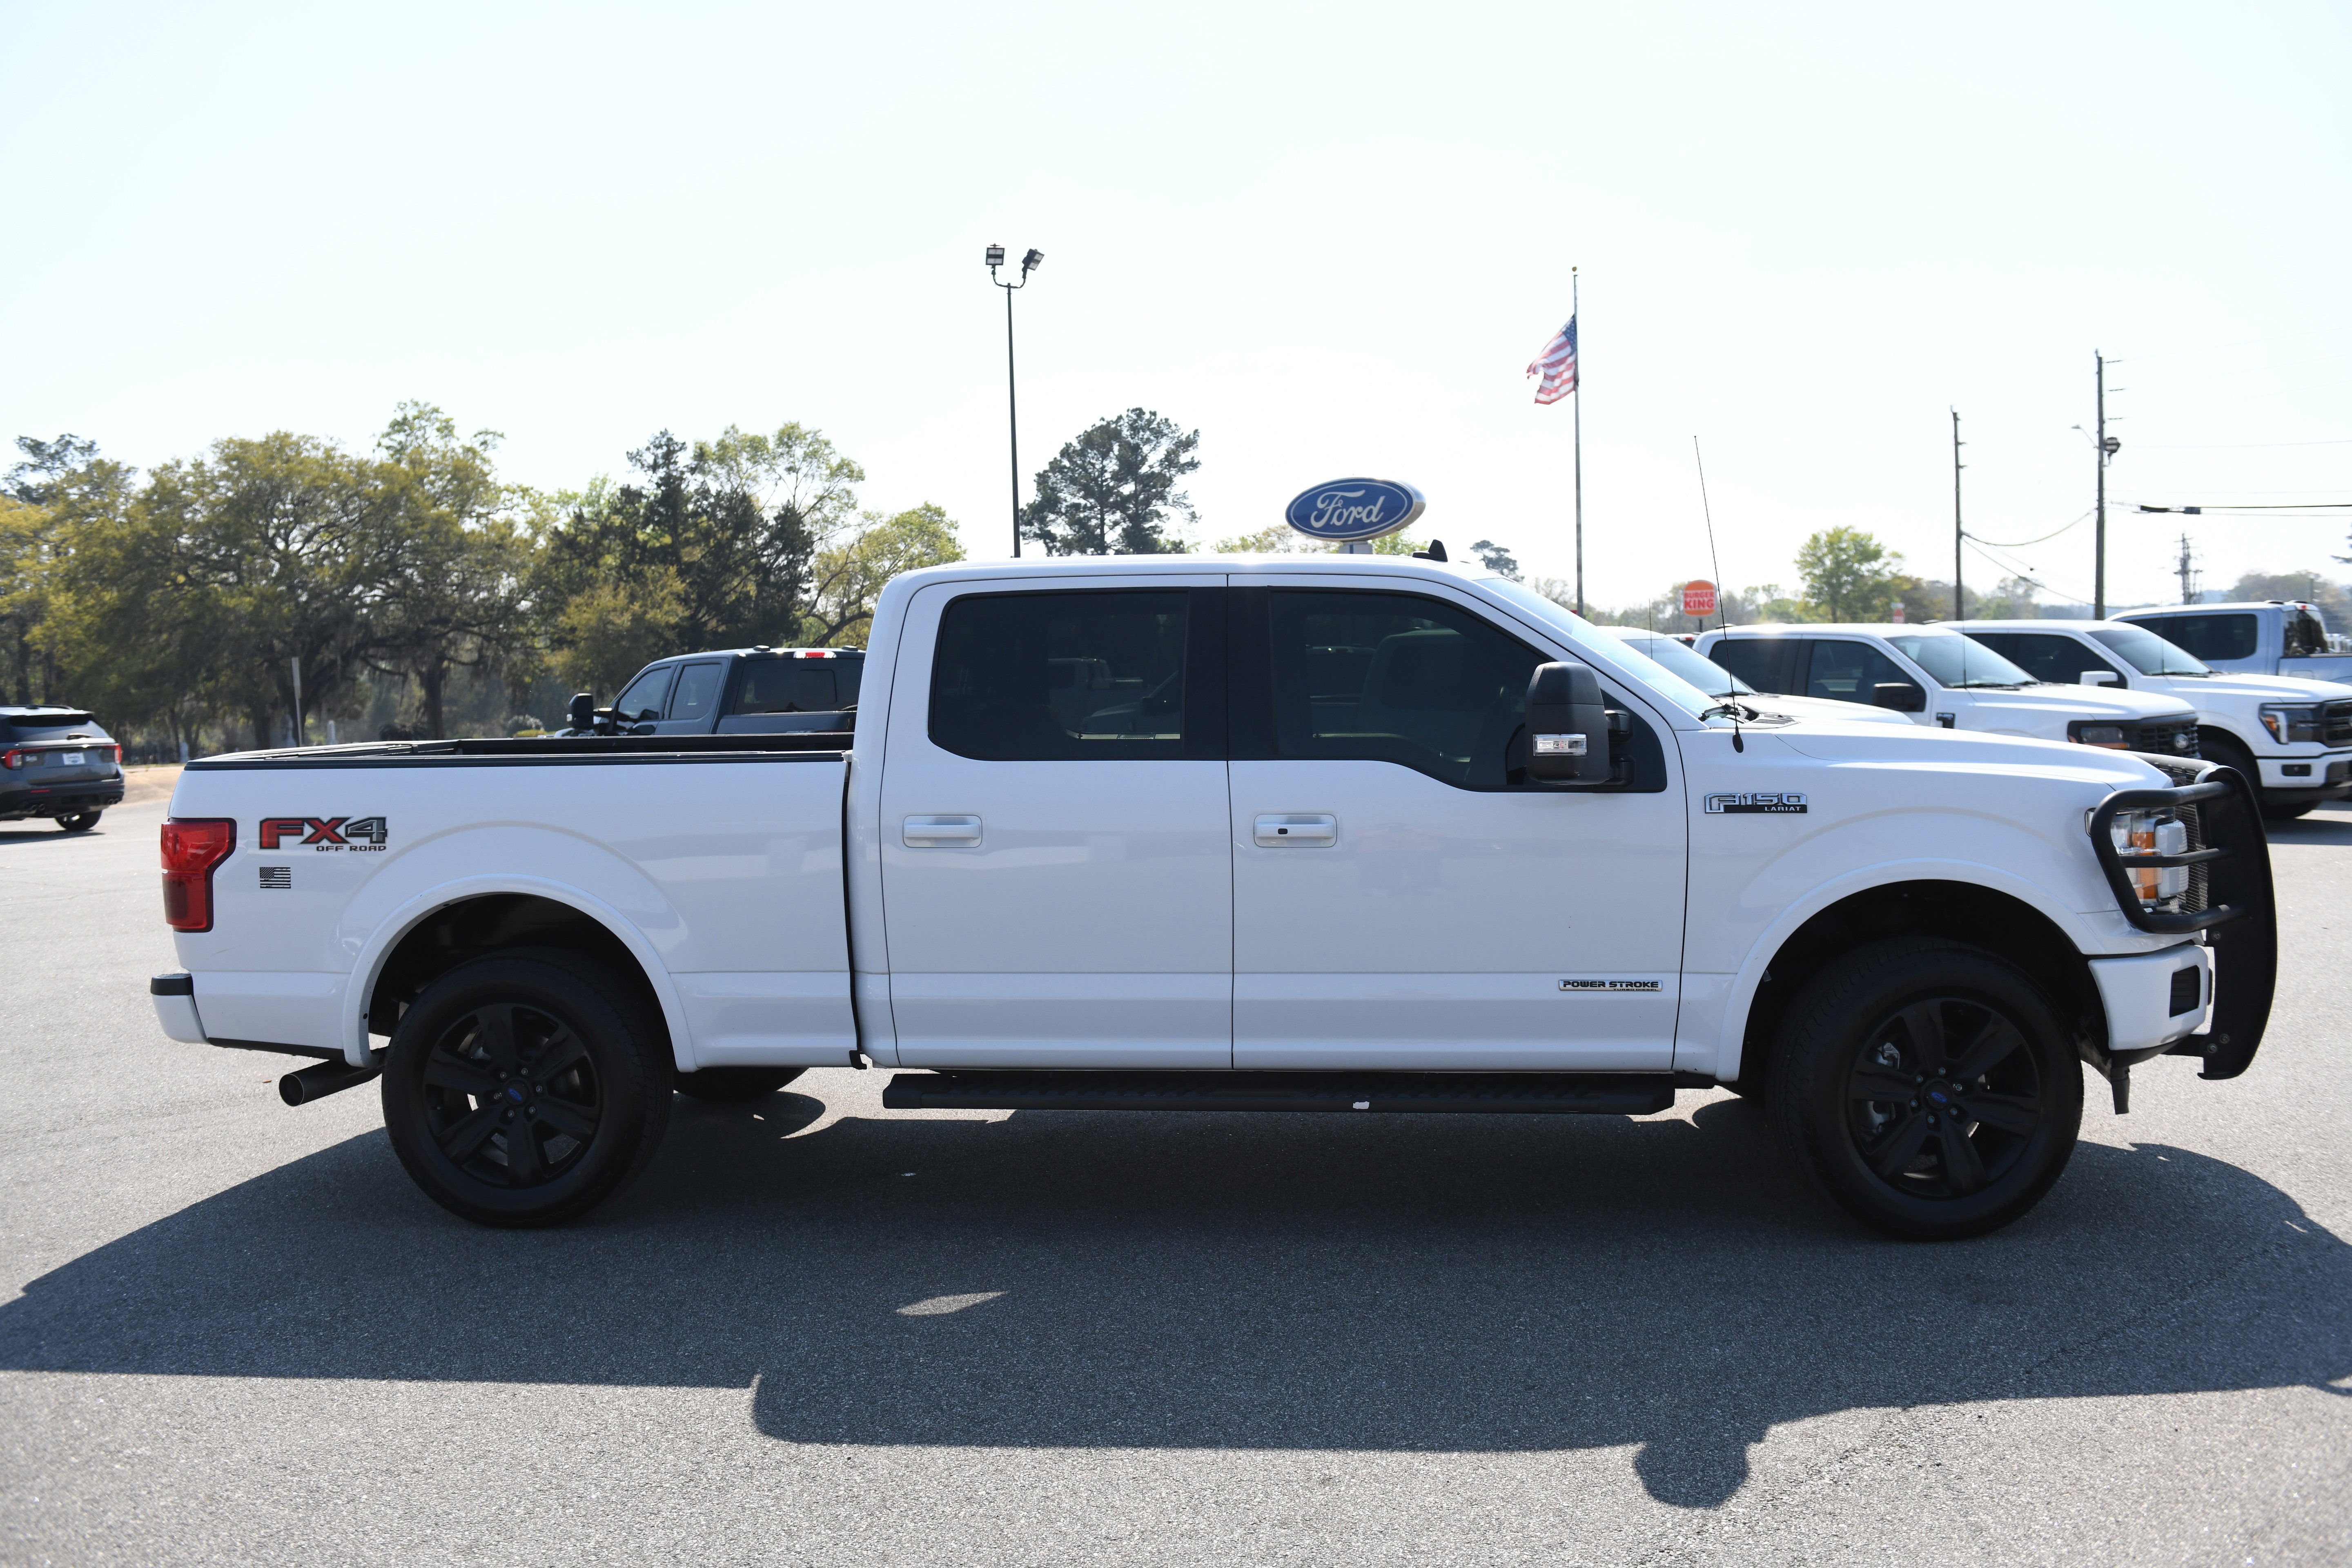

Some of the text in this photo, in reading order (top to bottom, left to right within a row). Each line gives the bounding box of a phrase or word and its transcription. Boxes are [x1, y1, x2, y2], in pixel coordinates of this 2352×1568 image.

[1310, 490, 1385, 528] Ford
[1684, 599, 1714, 608] KING
[259, 816, 388, 850] FX4
